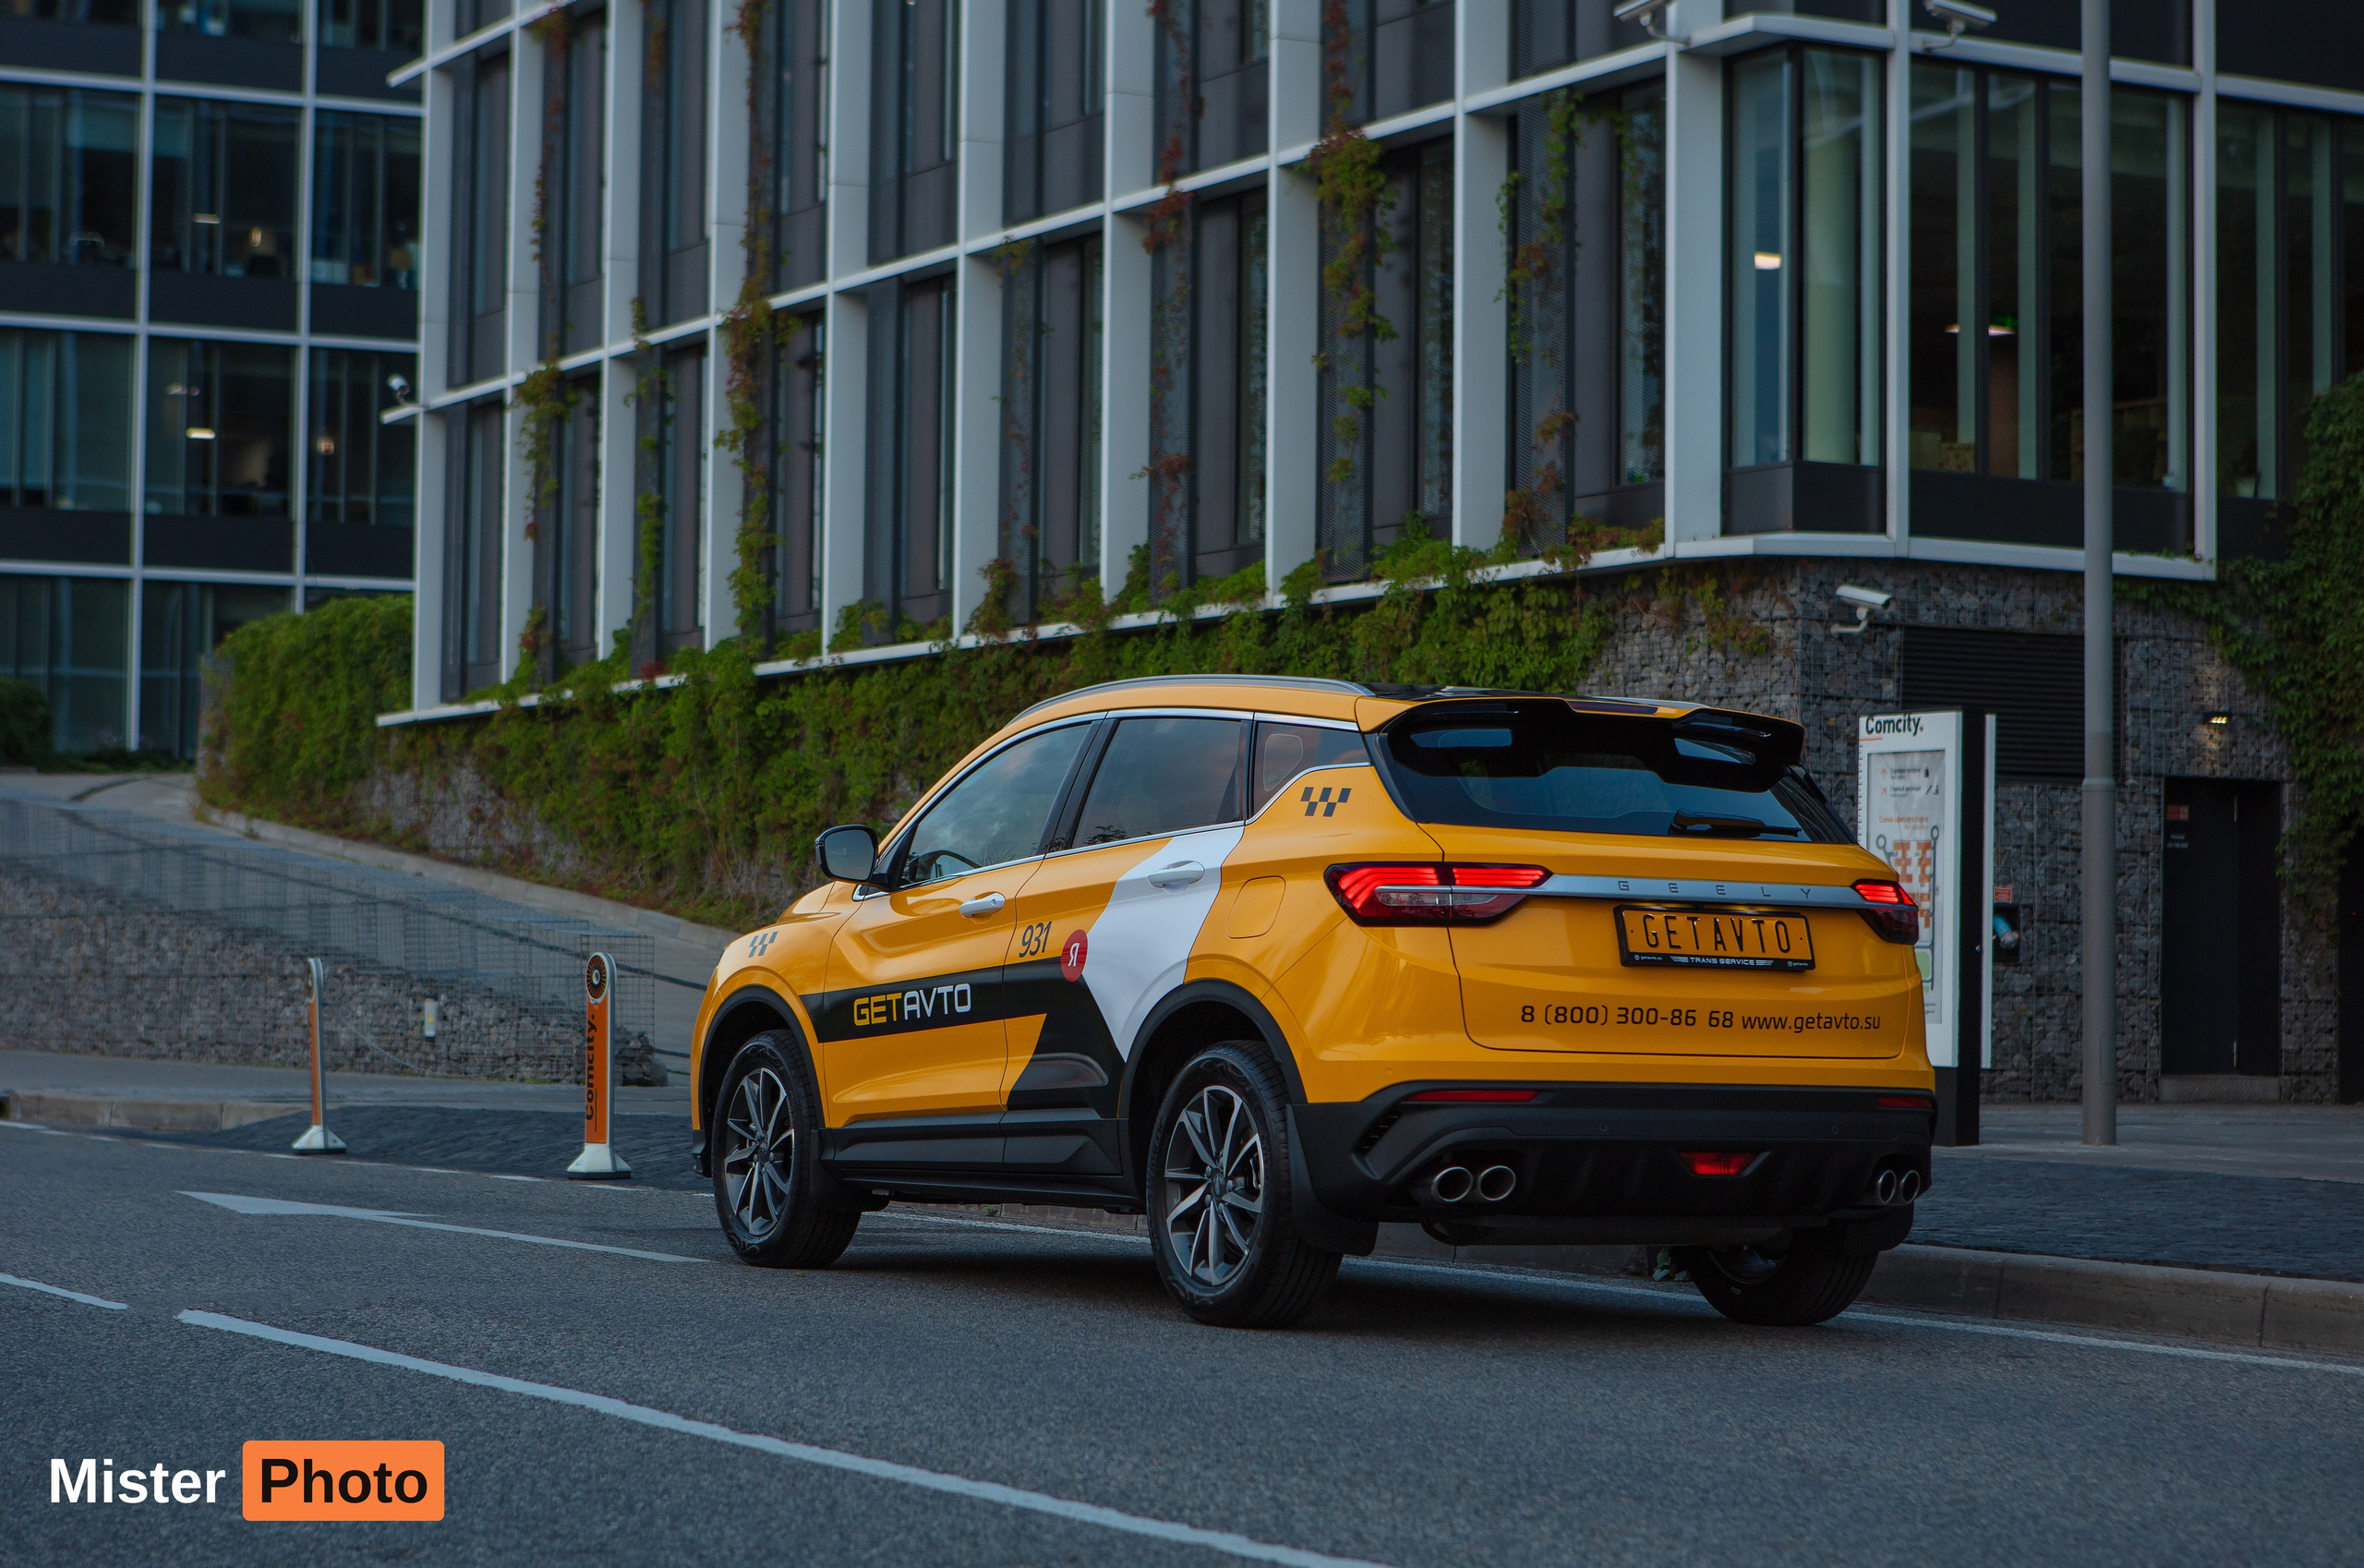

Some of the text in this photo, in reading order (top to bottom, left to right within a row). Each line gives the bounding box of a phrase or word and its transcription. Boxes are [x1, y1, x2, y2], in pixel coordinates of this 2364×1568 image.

[1865, 713, 1924, 737] Comcity.
[1617, 880, 1811, 899] GEELY
[1019, 921, 1052, 959] 931
[1642, 914, 1791, 953] GETAVTO
[1719, 958, 1755, 966] SERVICE
[853, 983, 971, 1027] GETAVTO
[1521, 1004, 1881, 1033] 8 (800) 300-86 68 www.getavto.su
